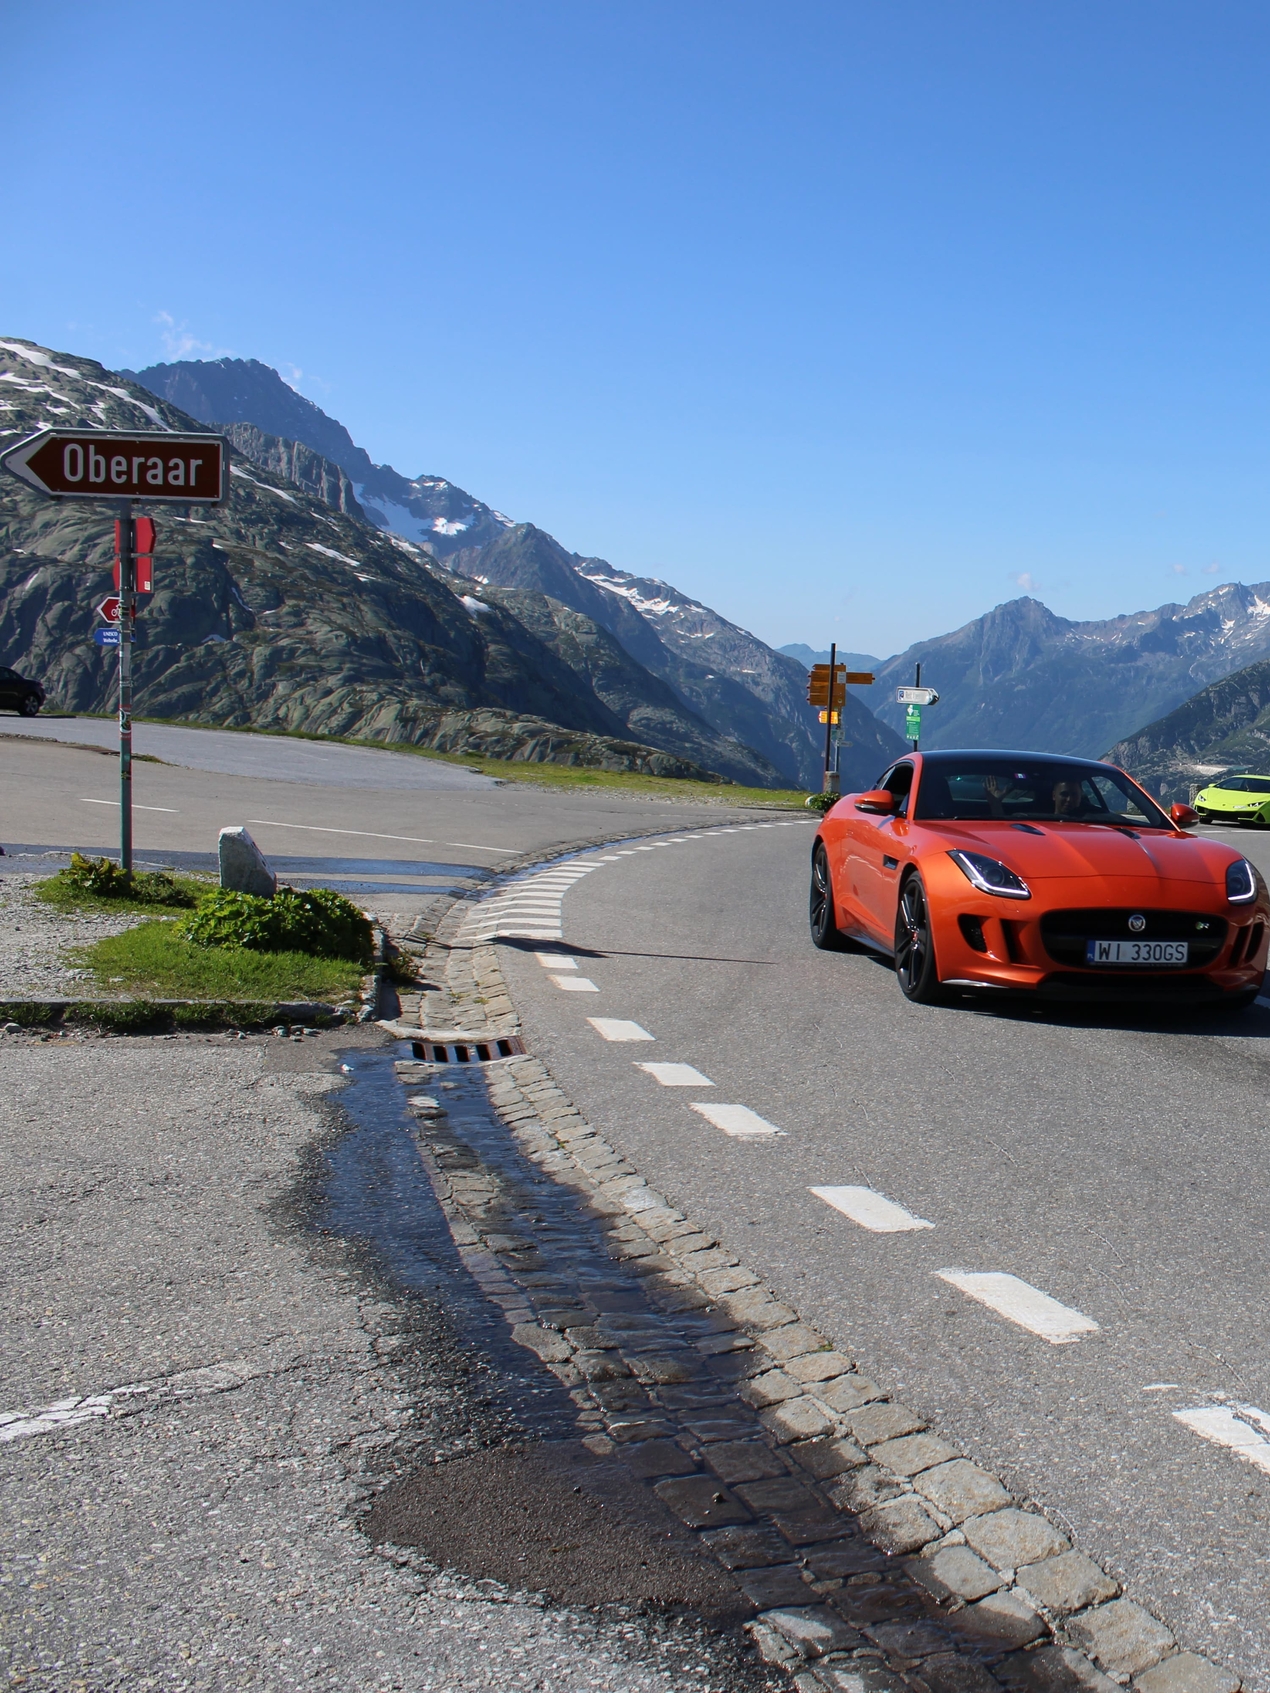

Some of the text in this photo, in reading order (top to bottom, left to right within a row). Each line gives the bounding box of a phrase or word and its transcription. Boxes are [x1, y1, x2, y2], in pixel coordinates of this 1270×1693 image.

[63, 443, 203, 486] Oberaar
[1098, 942, 1186, 962] WI 330GS
